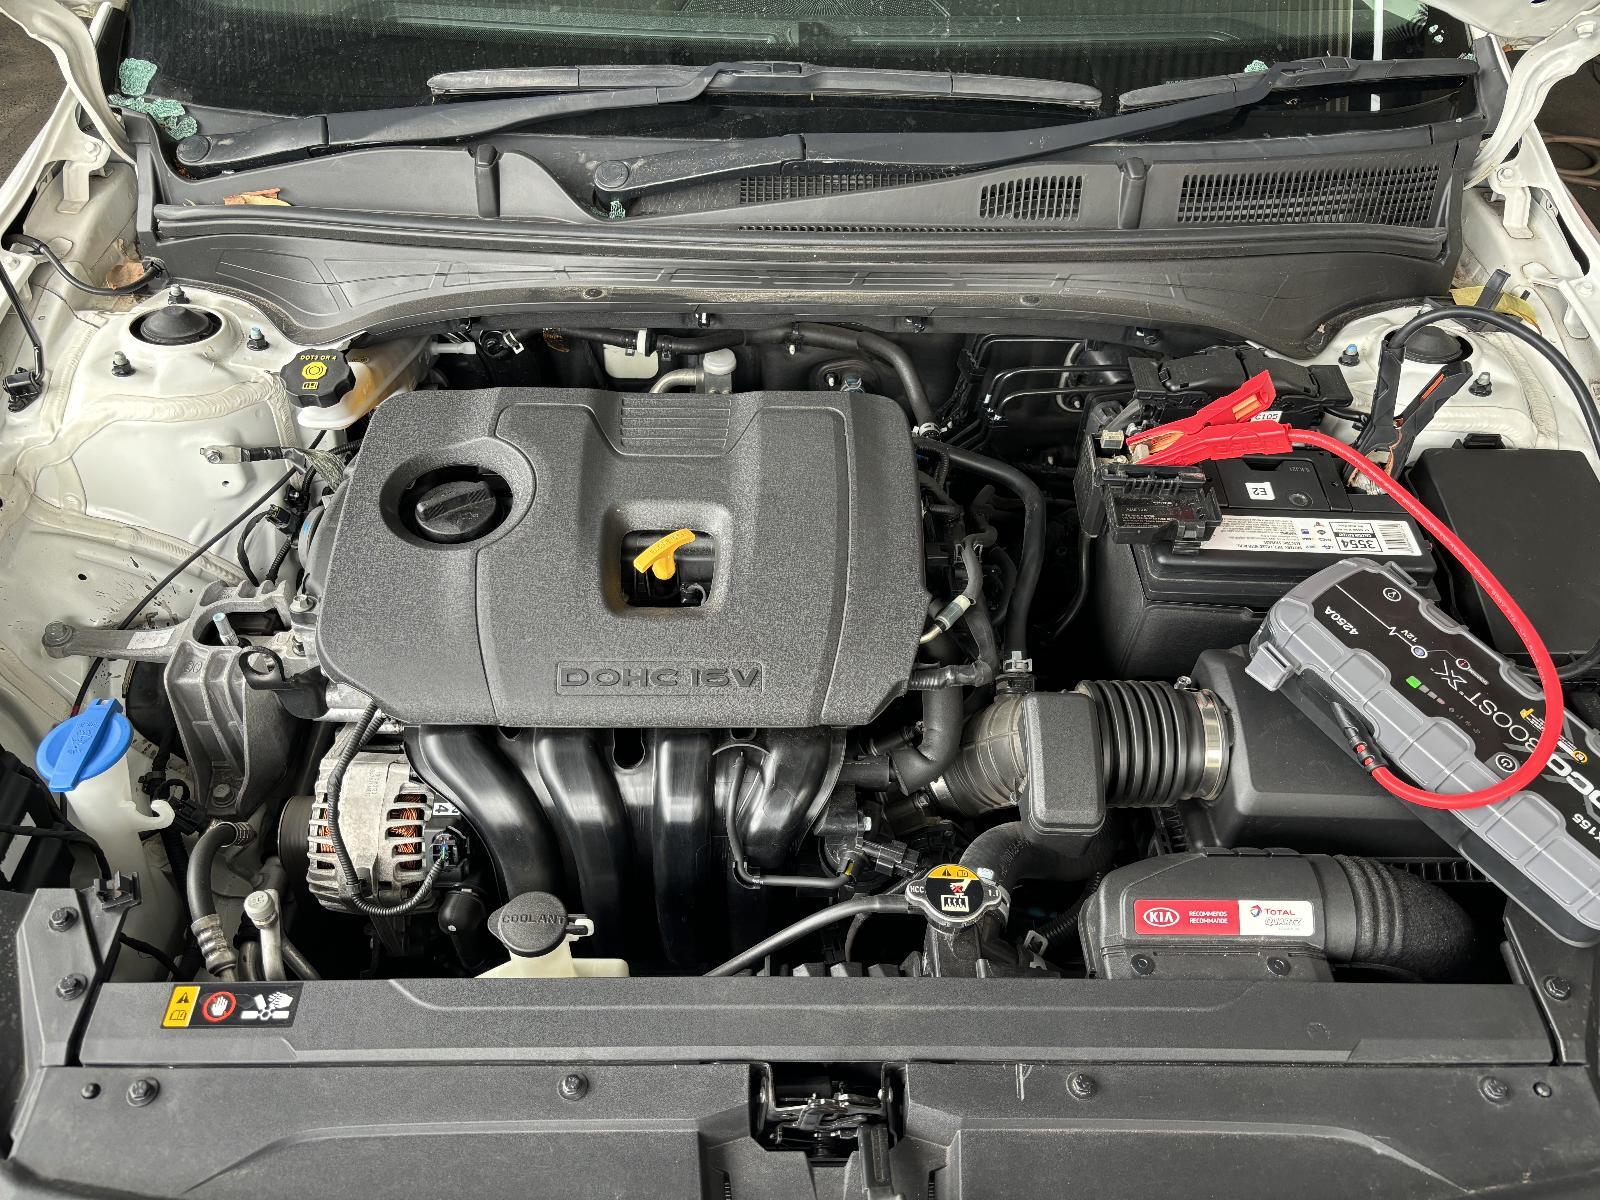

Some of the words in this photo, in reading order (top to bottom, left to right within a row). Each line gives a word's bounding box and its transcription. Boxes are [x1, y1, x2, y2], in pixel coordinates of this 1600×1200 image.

[1251, 487, 1268, 496] E2
[1340, 539, 1376, 549] 3554
[1324, 605, 1360, 635] 4250A
[1400, 629, 1418, 643] 12V
[560, 668, 680, 687] DOHC
[690, 668, 760, 688] 16V
[1149, 911, 1175, 923] KIA
[1264, 908, 1296, 916] TOTAL
[502, 913, 567, 925] COOLANT
